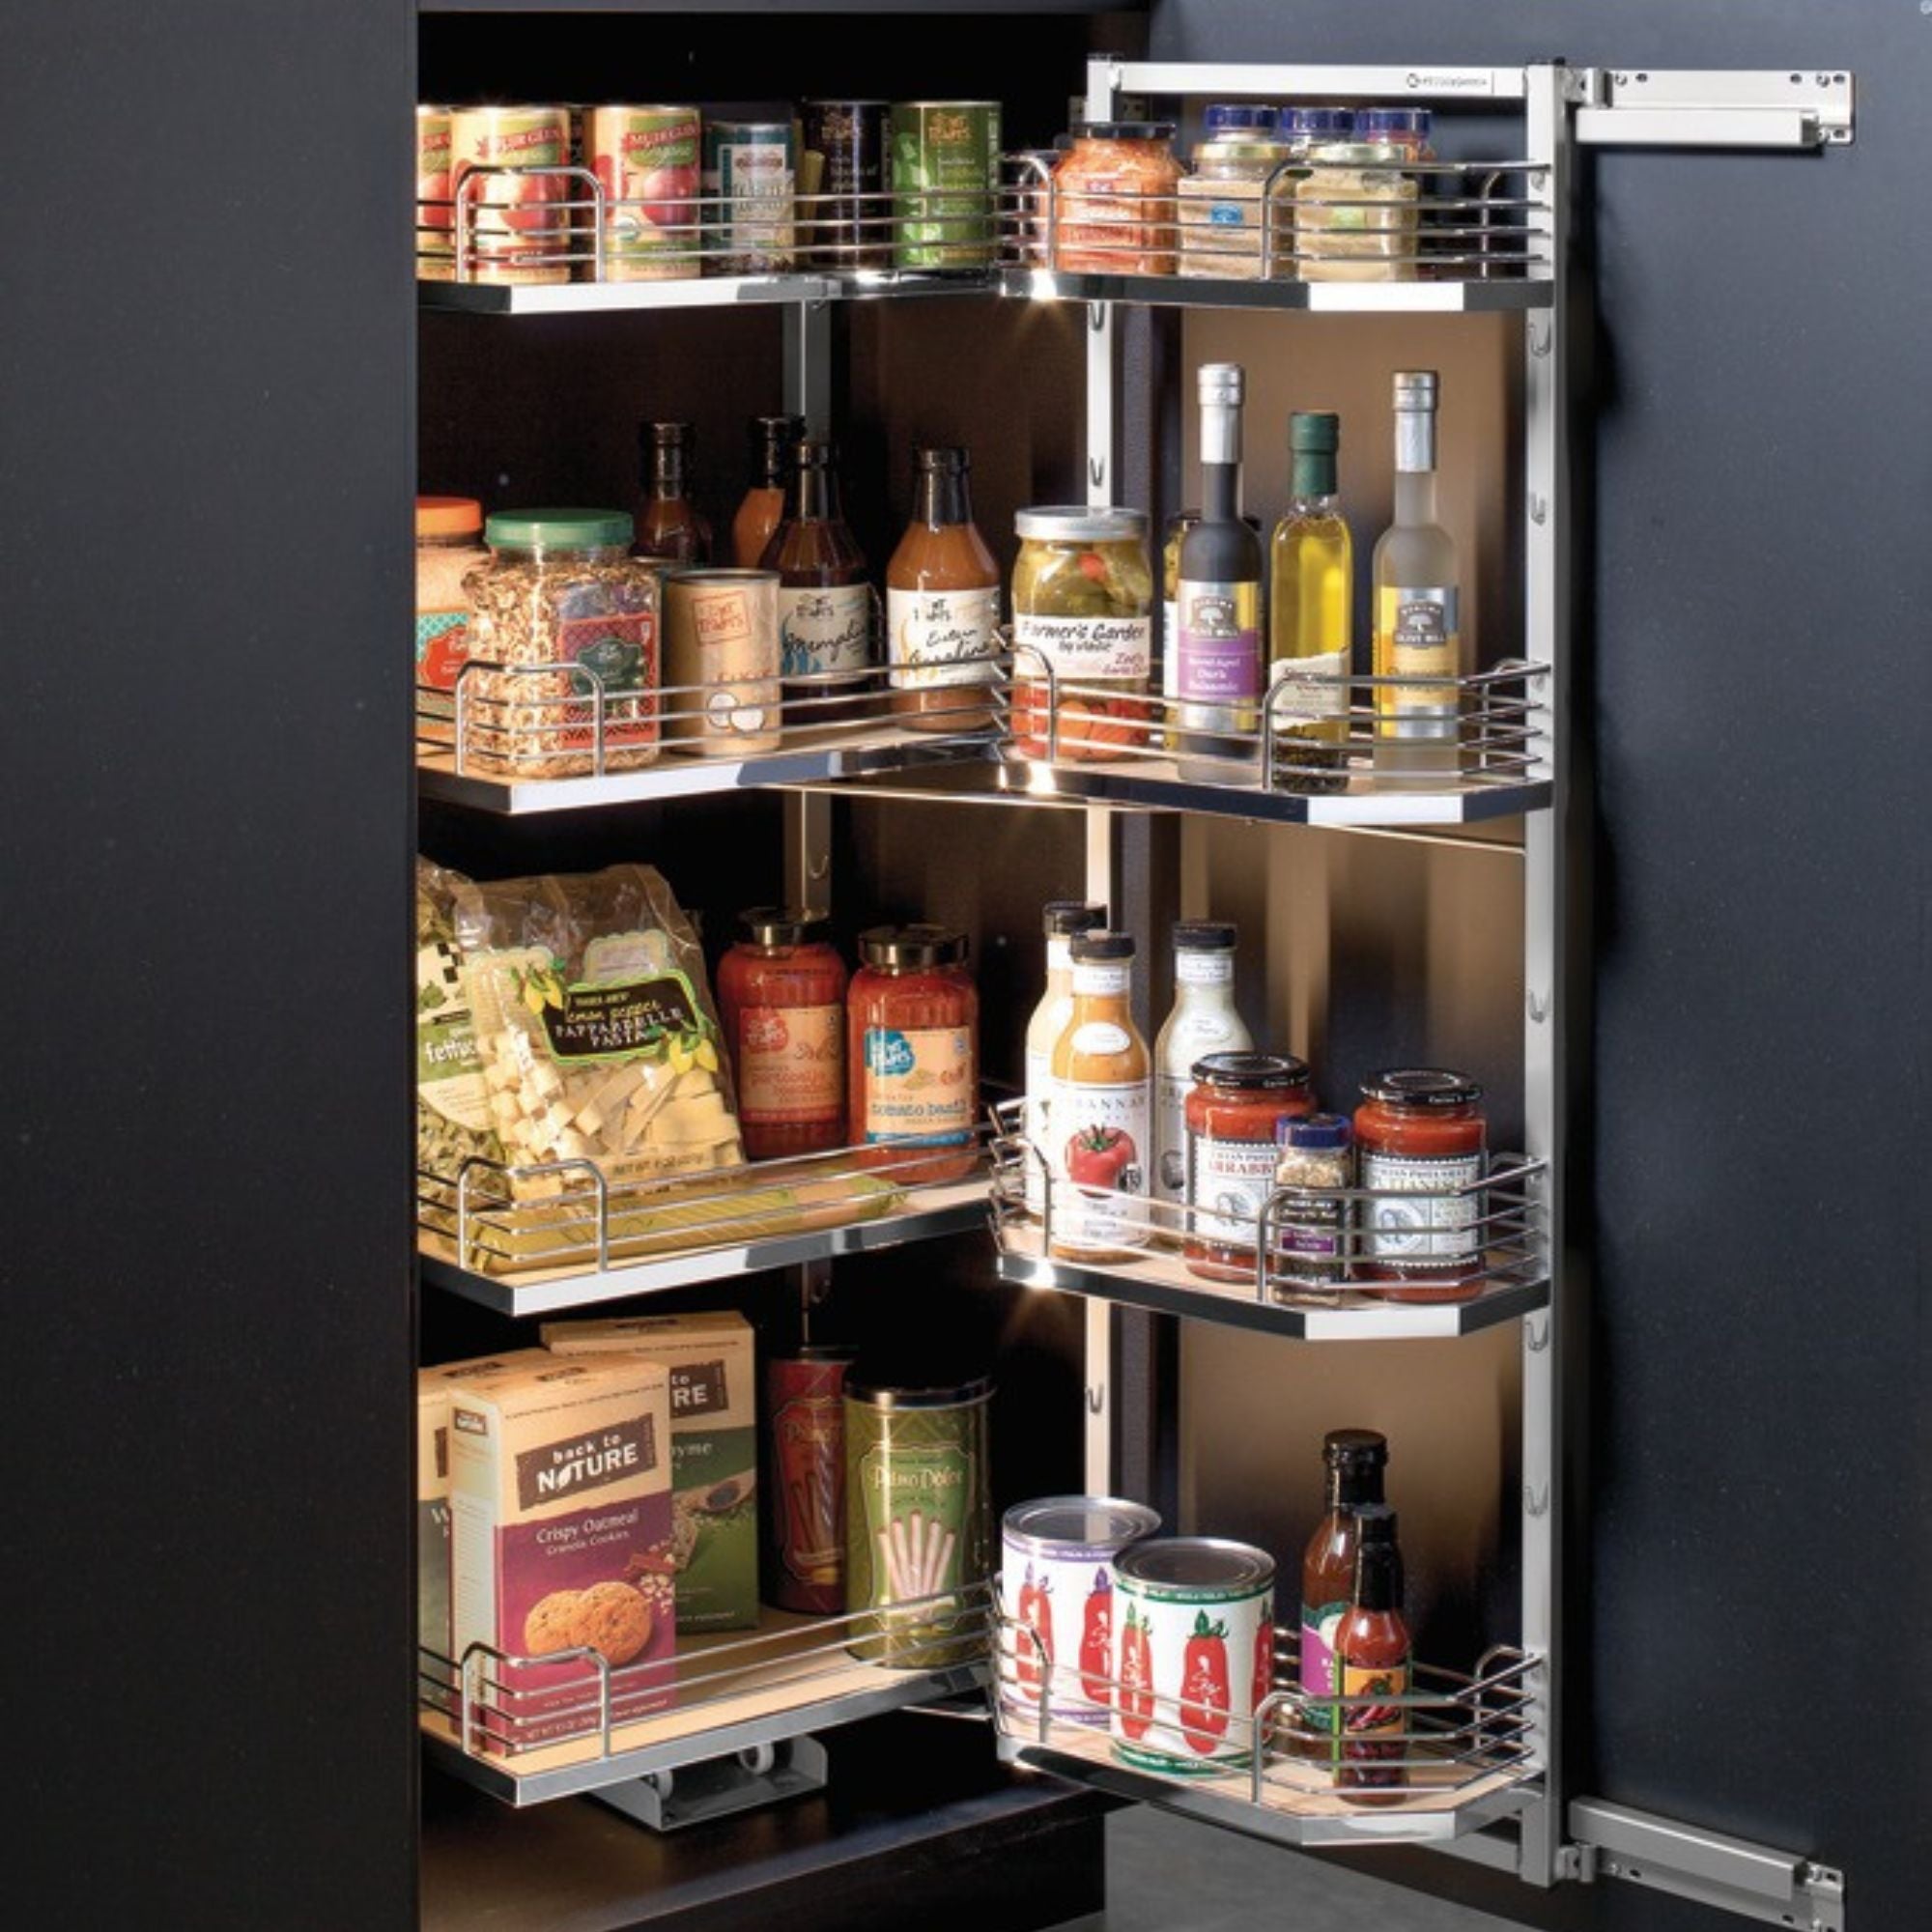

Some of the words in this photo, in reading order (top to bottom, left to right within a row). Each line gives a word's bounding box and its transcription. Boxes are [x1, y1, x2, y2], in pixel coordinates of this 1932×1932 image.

[552, 1439, 597, 1465] back
[603, 1433, 623, 1448] to
[535, 1524, 580, 1546] Crispy
[583, 1507, 640, 1535] Oatmeal
